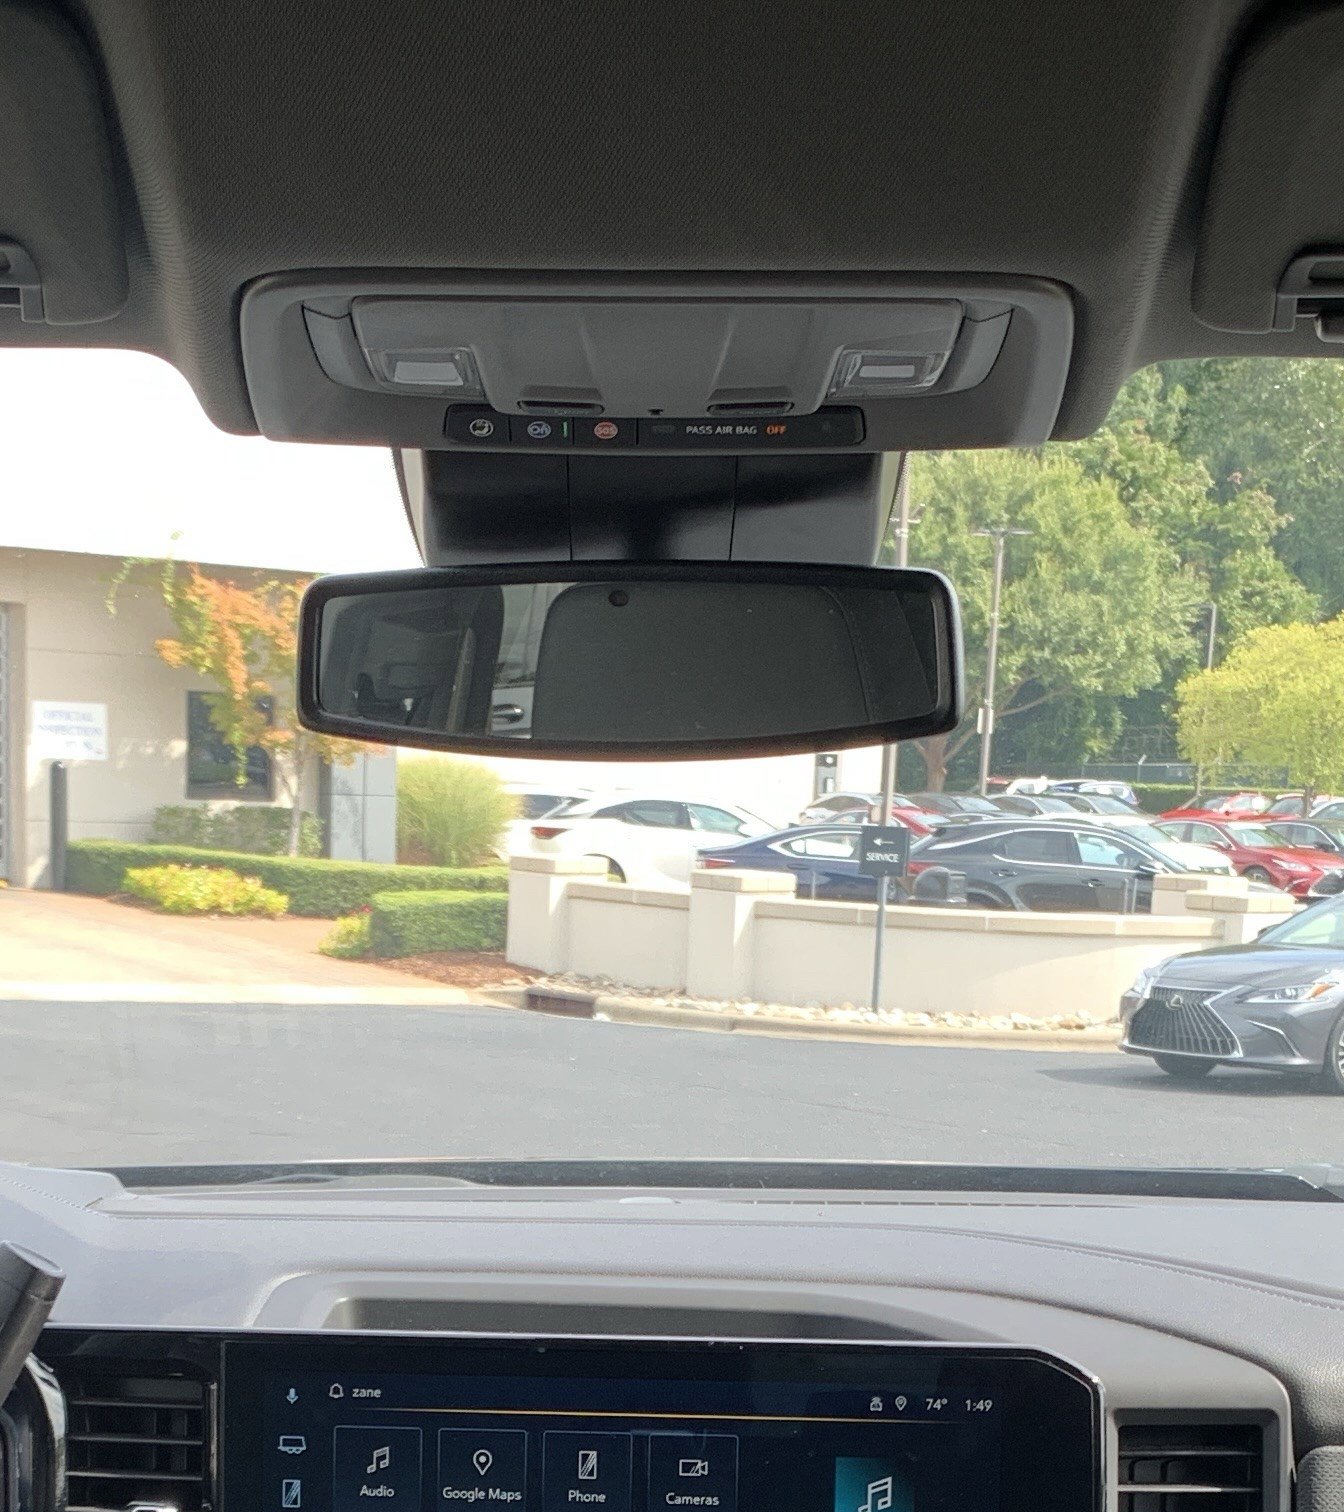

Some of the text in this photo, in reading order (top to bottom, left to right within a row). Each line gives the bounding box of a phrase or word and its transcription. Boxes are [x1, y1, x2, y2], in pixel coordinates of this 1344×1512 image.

[686, 425, 712, 435] PASS
[715, 425, 733, 435] AIR
[735, 425, 757, 435] BAG
[766, 425, 787, 435] OFF
[866, 852, 899, 863] SERVICE
[352, 1389, 382, 1398] zane
[925, 1398, 993, 1412] 74° 1:49
[359, 1483, 395, 1498] Audio
[442, 1486, 523, 1502] Google Maps
[568, 1489, 606, 1503] Phone
[665, 1493, 720, 1507] Cameras
